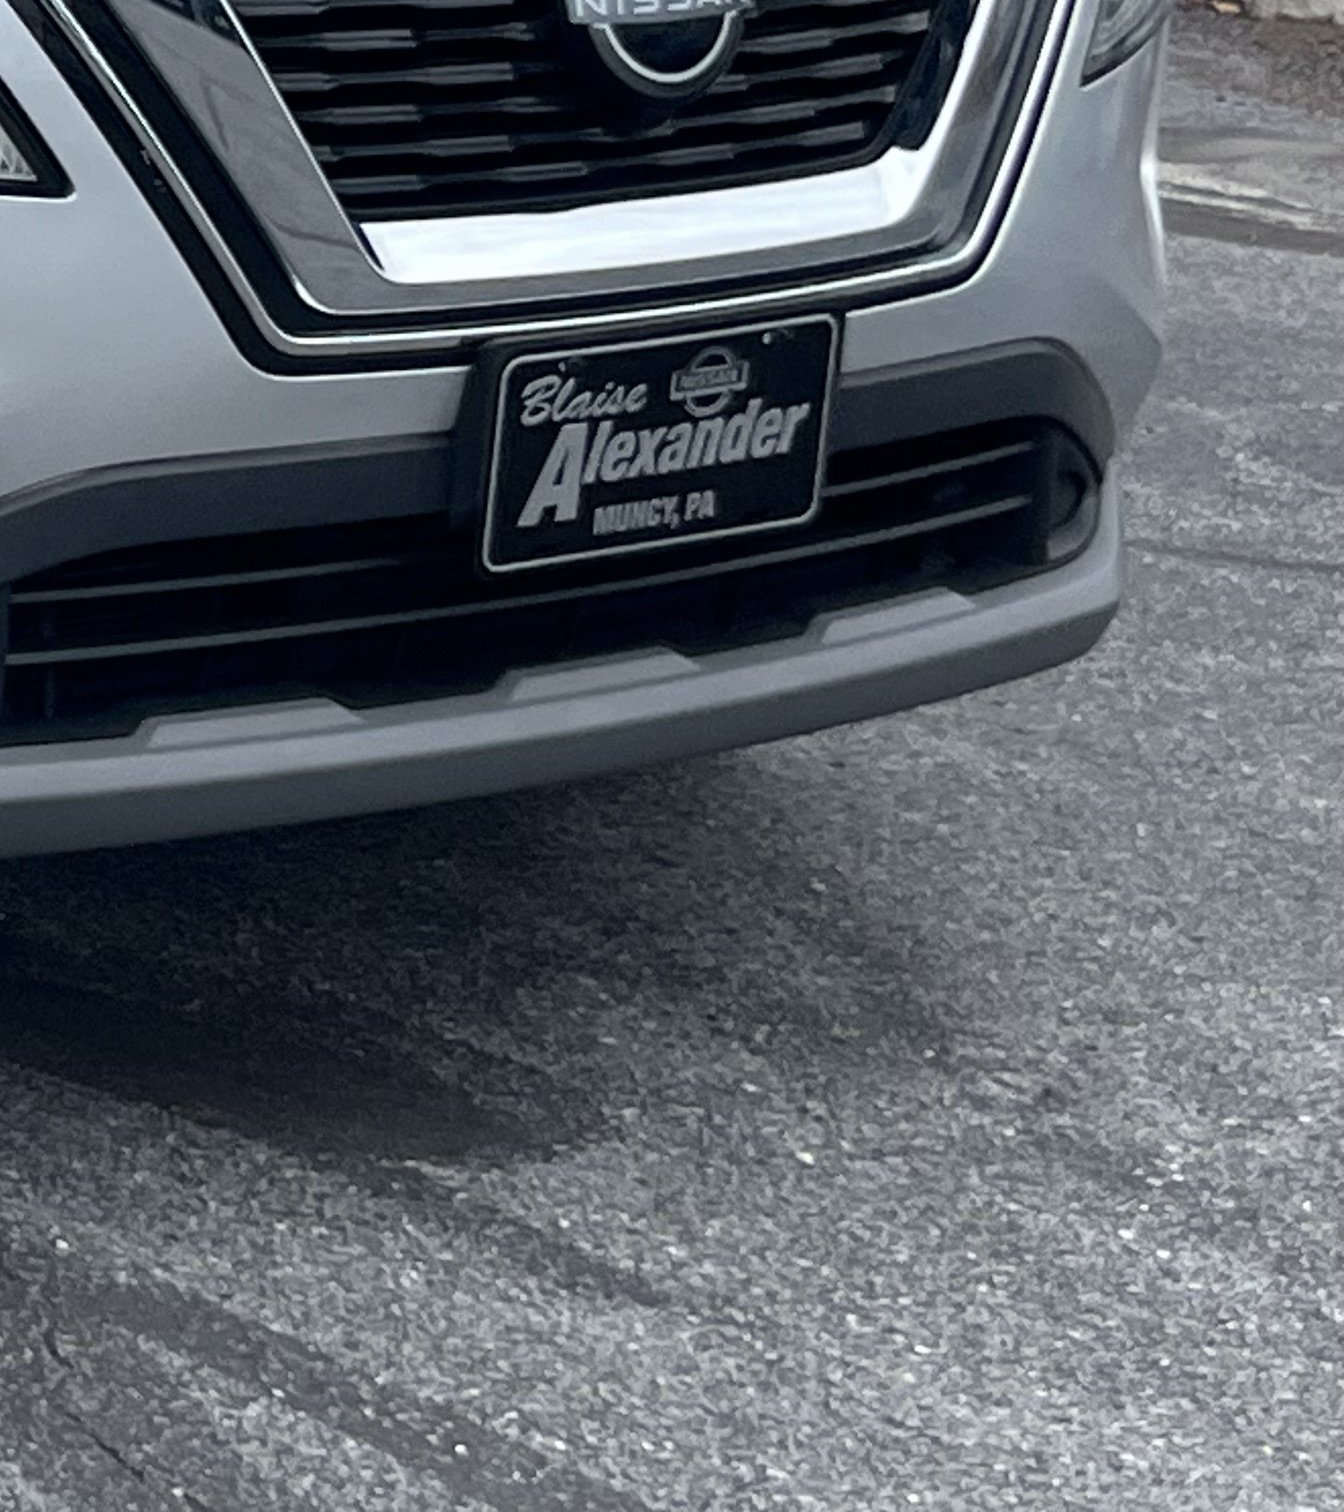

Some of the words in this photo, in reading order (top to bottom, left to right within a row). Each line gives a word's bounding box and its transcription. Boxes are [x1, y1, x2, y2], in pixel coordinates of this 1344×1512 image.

[520, 374, 648, 427] Blaise
[516, 397, 811, 528] Alexander
[683, 489, 715, 522] PA
